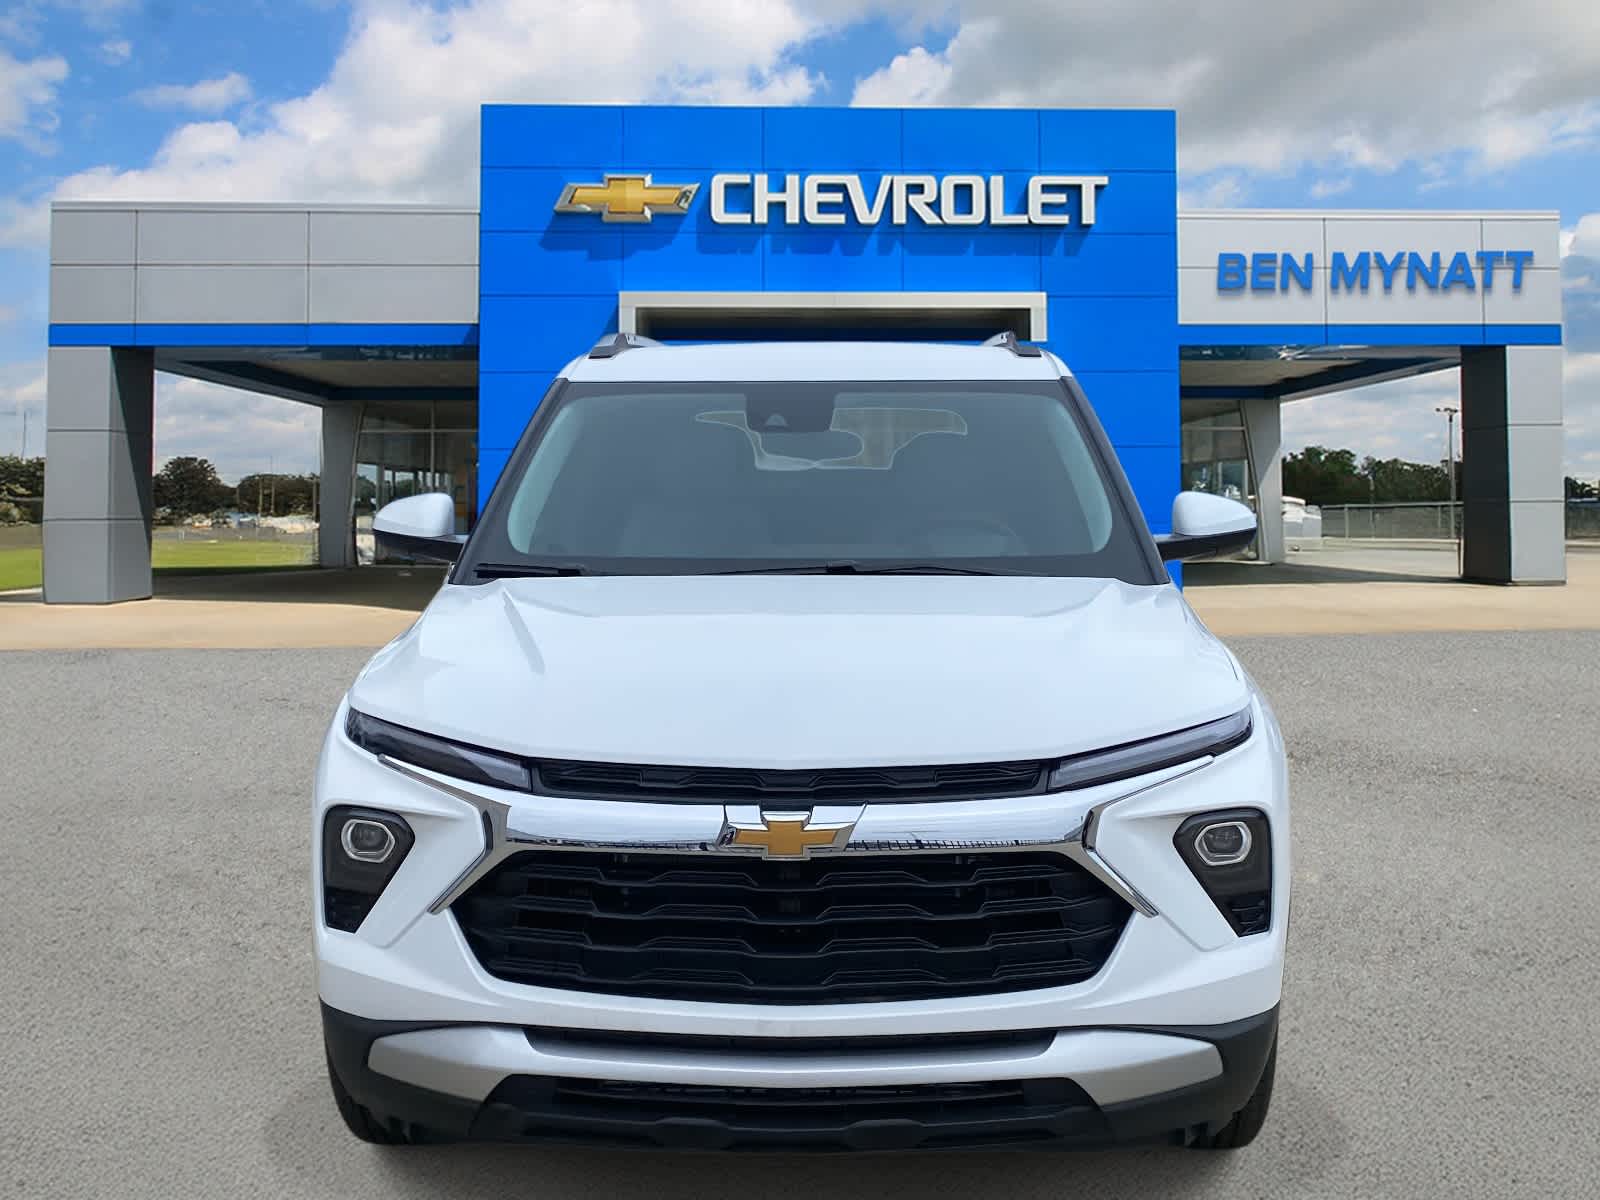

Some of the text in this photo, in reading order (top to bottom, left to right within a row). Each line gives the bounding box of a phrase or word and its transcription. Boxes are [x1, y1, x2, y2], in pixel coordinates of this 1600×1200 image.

[710, 173, 1110, 226] CHEVROLET
[1217, 250, 1534, 290] BEN MYNATT
